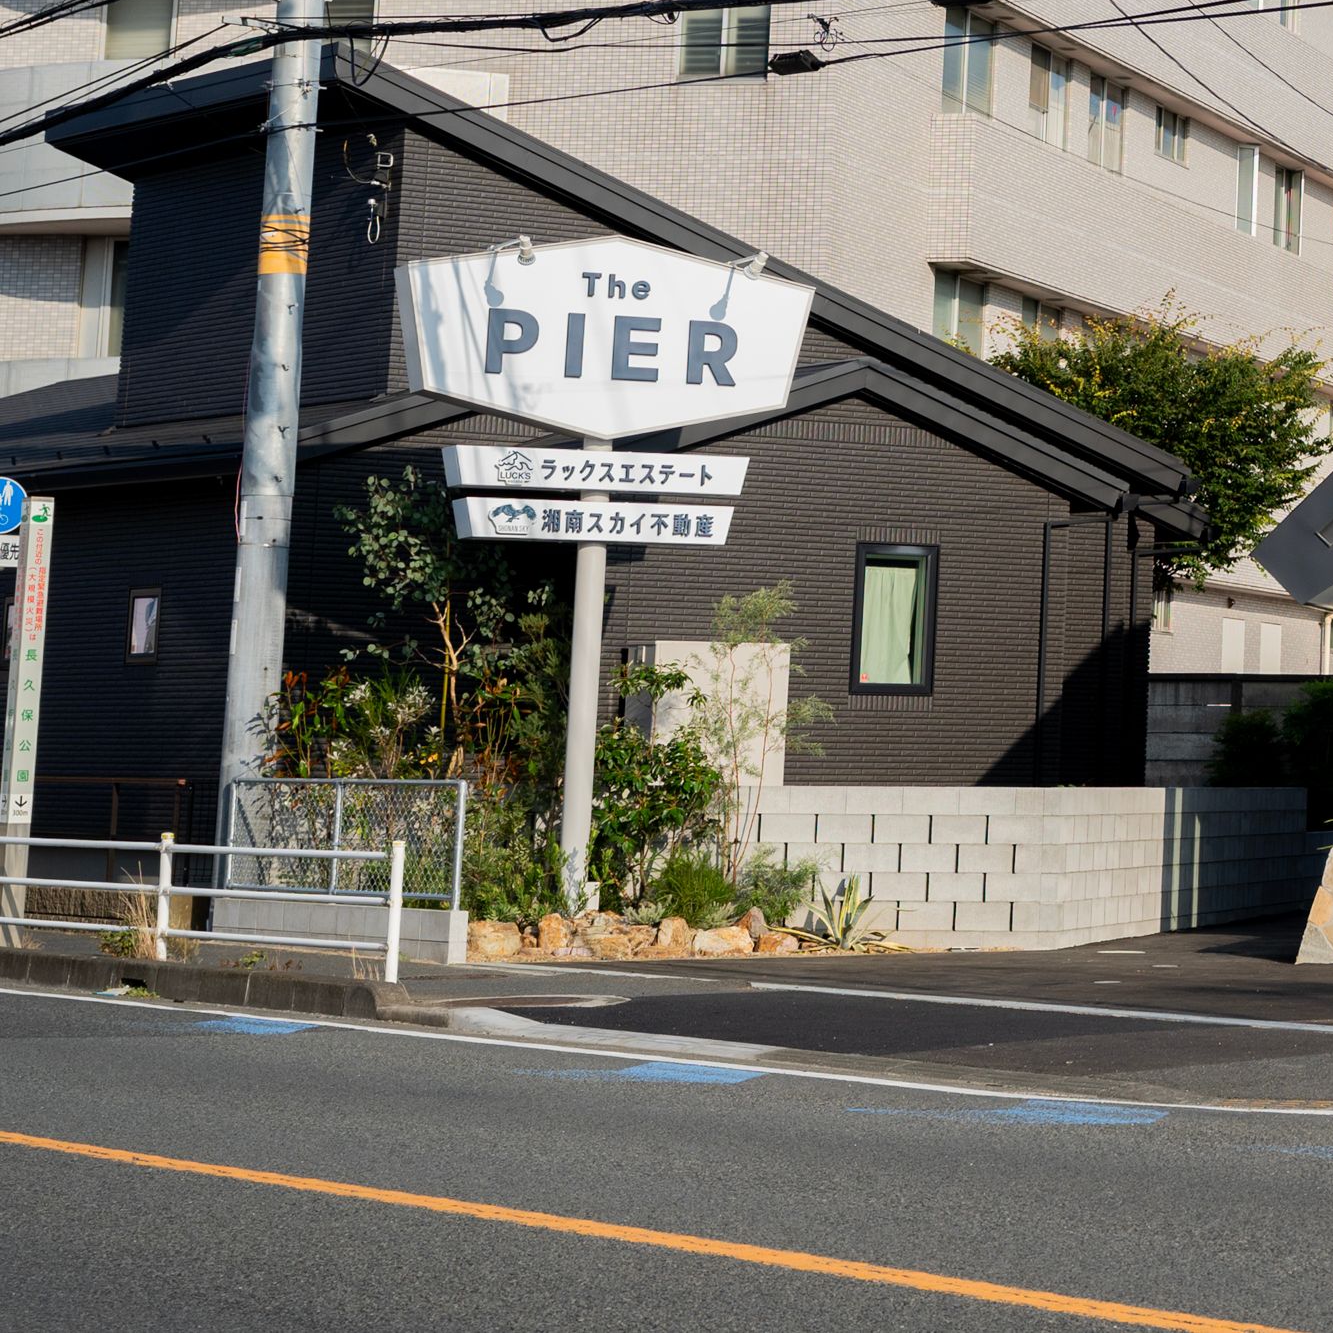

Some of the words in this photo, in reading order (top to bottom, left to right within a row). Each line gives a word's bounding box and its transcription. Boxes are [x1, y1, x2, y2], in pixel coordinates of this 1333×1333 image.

[582, 272, 651, 299] The
[484, 307, 738, 387] PIER
[541, 459, 713, 486] ラックスエステート
[541, 509, 714, 538] 湘南スカイ不動産
[16, 649, 38, 782] 長久保公園
